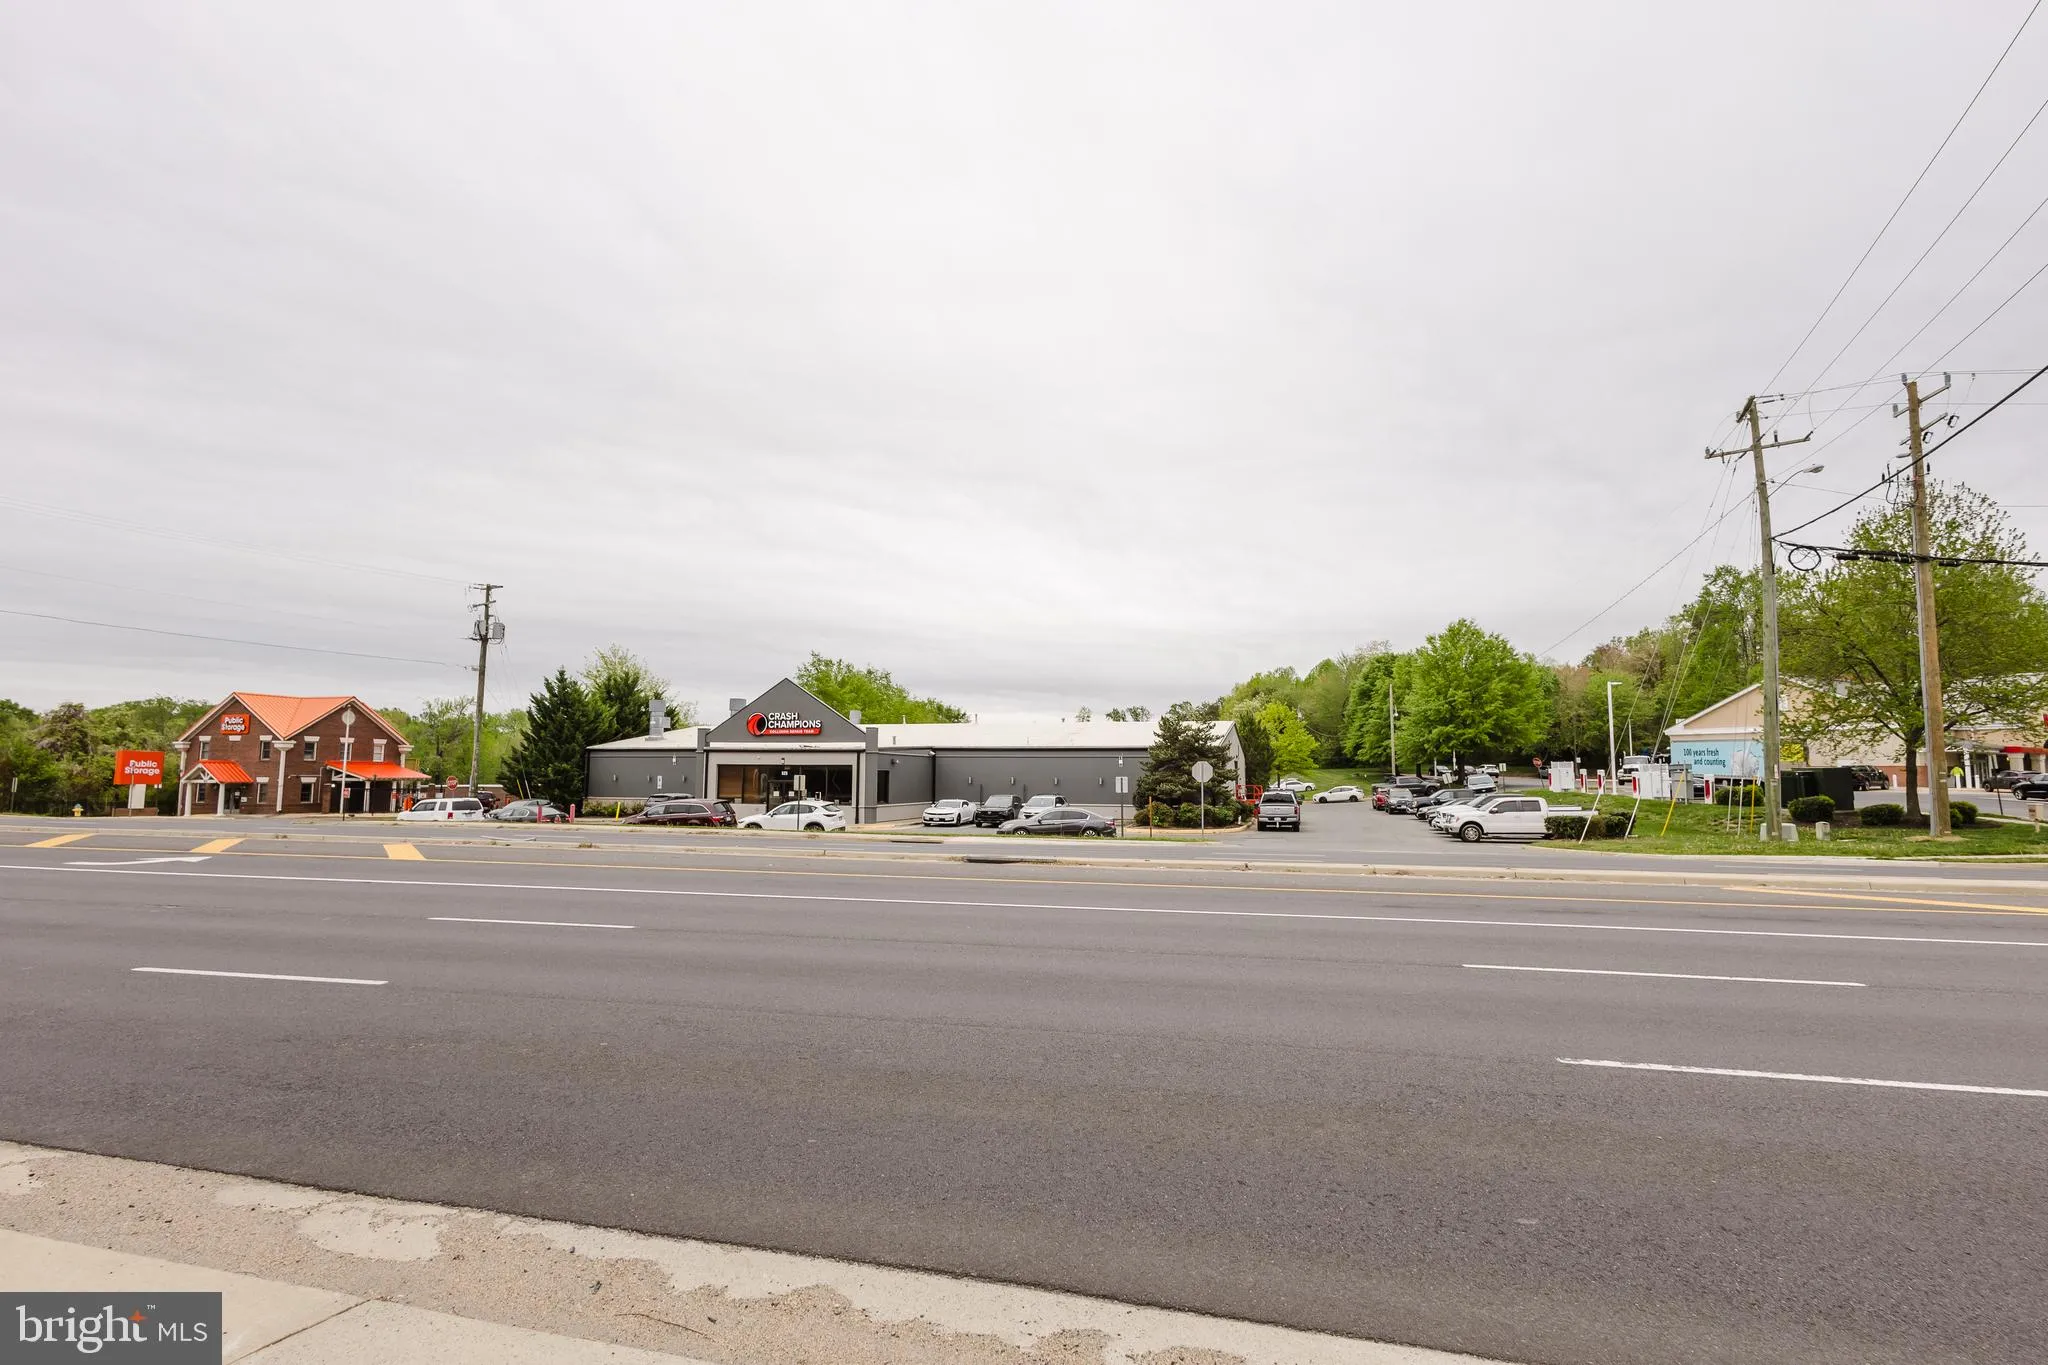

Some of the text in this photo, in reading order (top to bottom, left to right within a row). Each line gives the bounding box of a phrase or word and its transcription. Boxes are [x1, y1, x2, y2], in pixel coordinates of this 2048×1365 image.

[768, 712, 798, 720] CRASH
[222, 723, 245, 732] Storage
[768, 720, 821, 728] CHAMPIONS
[1683, 747, 1720, 759] 100 years fresh
[129, 760, 158, 768] Public
[1694, 758, 1726, 768] and counting
[124, 766, 161, 776] Storage
